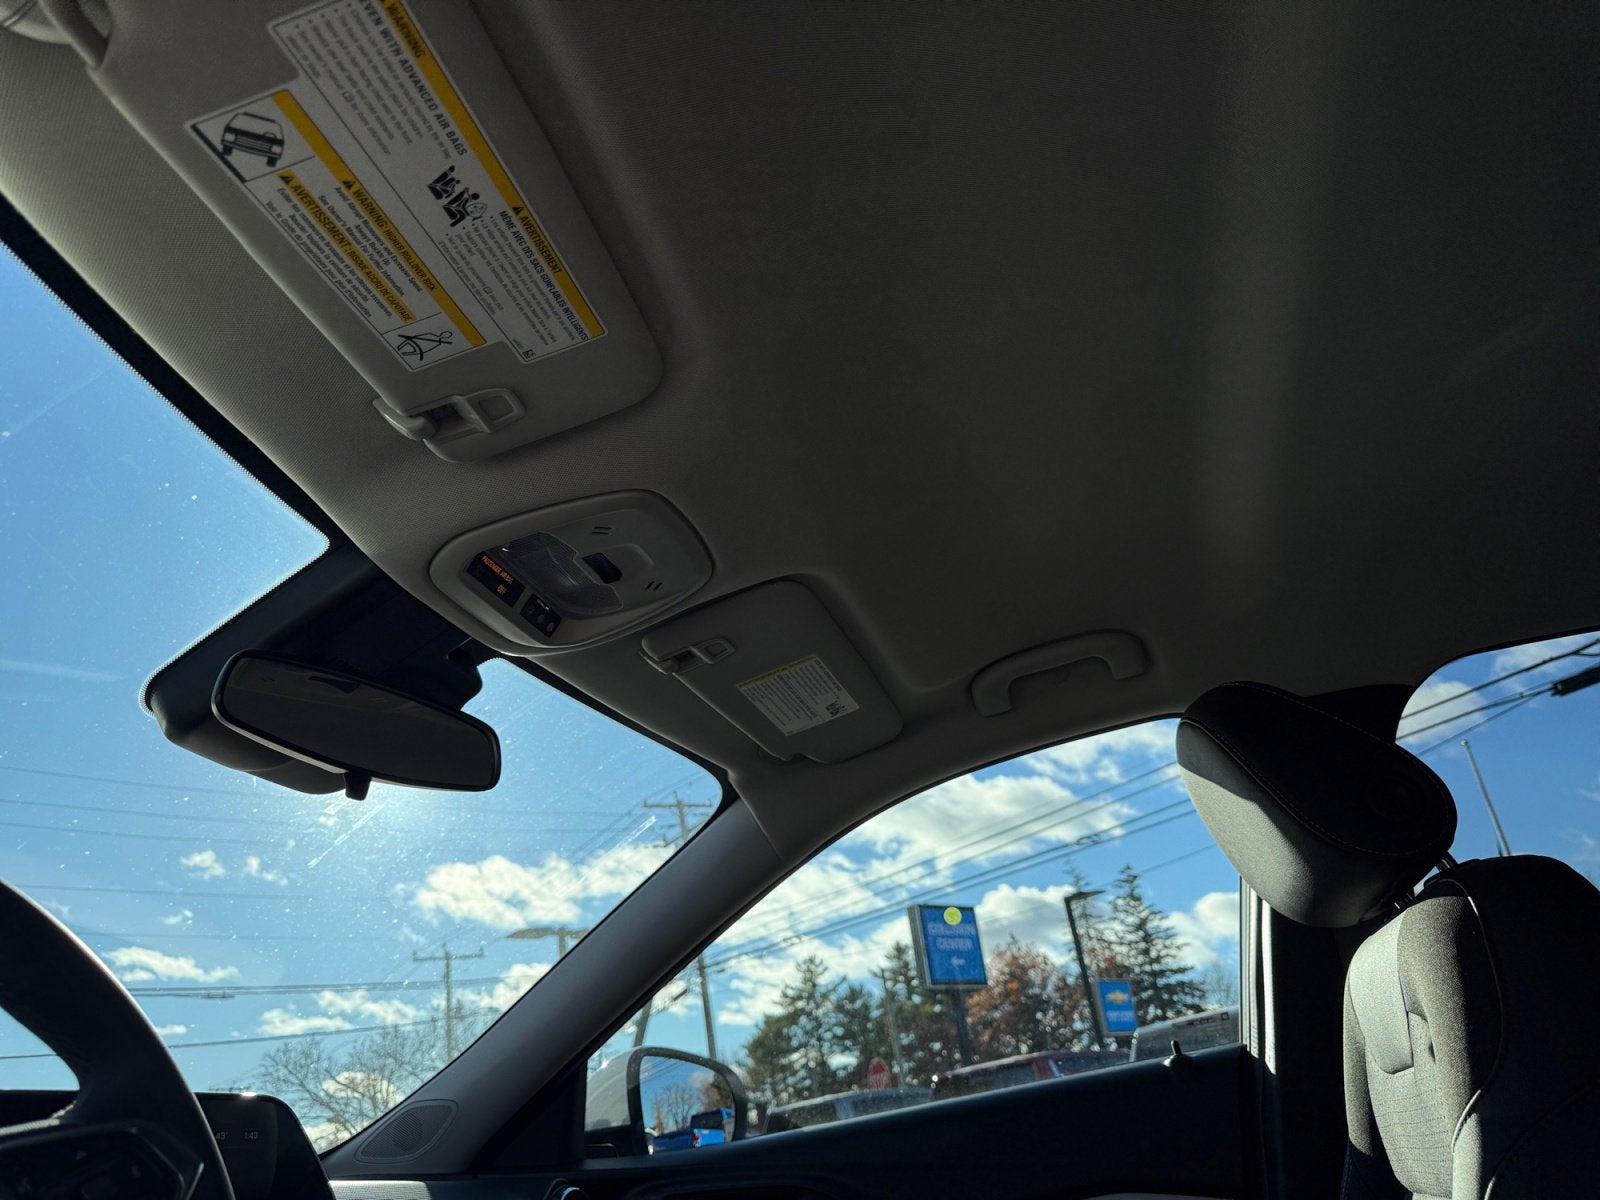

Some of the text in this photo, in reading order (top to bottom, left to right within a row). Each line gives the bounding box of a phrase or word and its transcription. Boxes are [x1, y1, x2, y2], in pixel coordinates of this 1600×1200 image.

[386, 3, 425, 57] WARNING
[380, 27, 402, 56] WITH
[399, 59, 437, 110] ADVANCED
[433, 113, 449, 129] AIR
[445, 130, 467, 155] BAGS
[292, 185, 351, 247] AVERTISSEMENT
[352, 189, 437, 291] WARNING: HIGHER ROLLOVER RISK
[520, 216, 561, 273] AVERTISSEMENT
[499, 210, 588, 340] MÊME AVEC DES SACS GONFLABLES INTELLIGENTS
